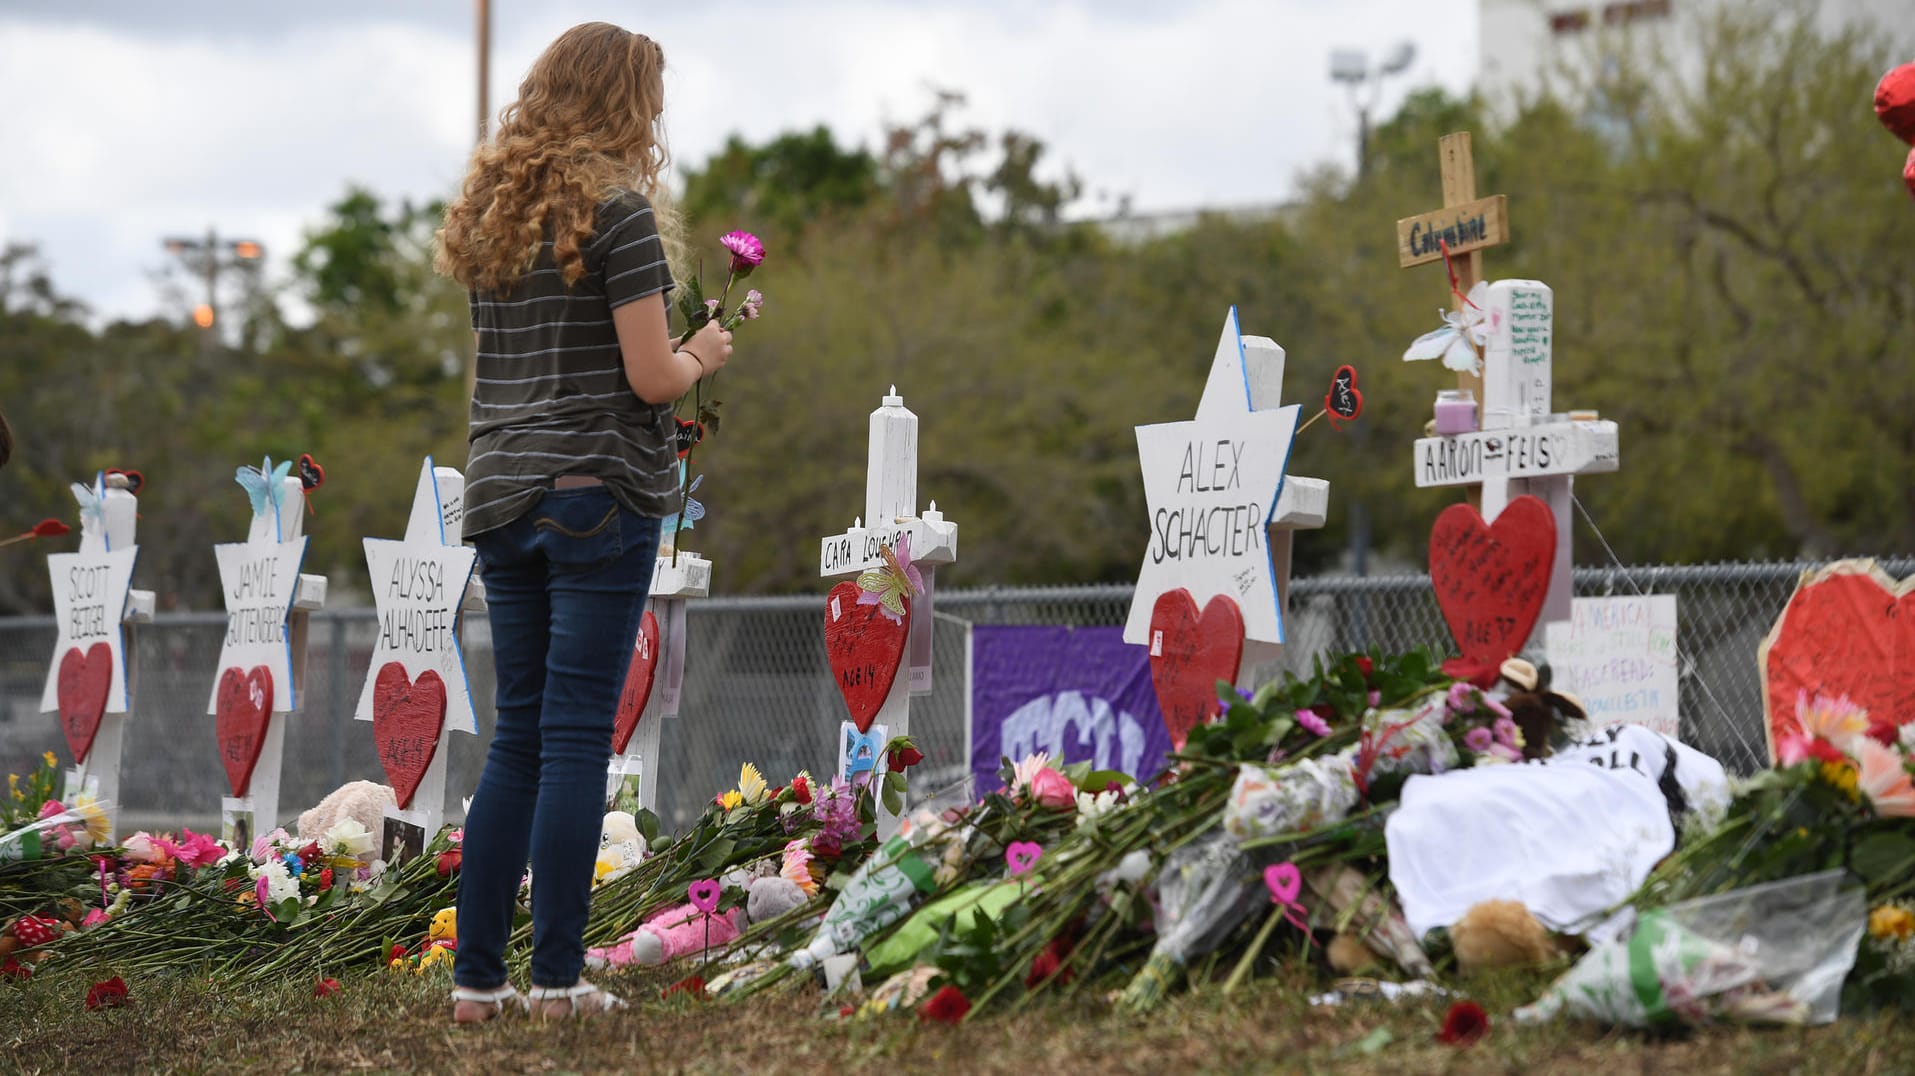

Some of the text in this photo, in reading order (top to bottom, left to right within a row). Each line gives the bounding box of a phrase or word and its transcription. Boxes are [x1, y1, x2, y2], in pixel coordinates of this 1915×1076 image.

[1410, 212, 1488, 257] Columbine
[1177, 440, 1245, 493] ALEX
[1425, 434, 1549, 481] AARON FEIS
[825, 530, 912, 570] CARA LOUHRN
[1153, 502, 1261, 565] SCHACTER
[69, 565, 111, 602] SCOTT
[233, 557, 279, 600] JAMIE
[389, 558, 444, 602] ALYSSA
[381, 608, 447, 653] ALHADEFF
[842, 663, 876, 689] AGE 14
